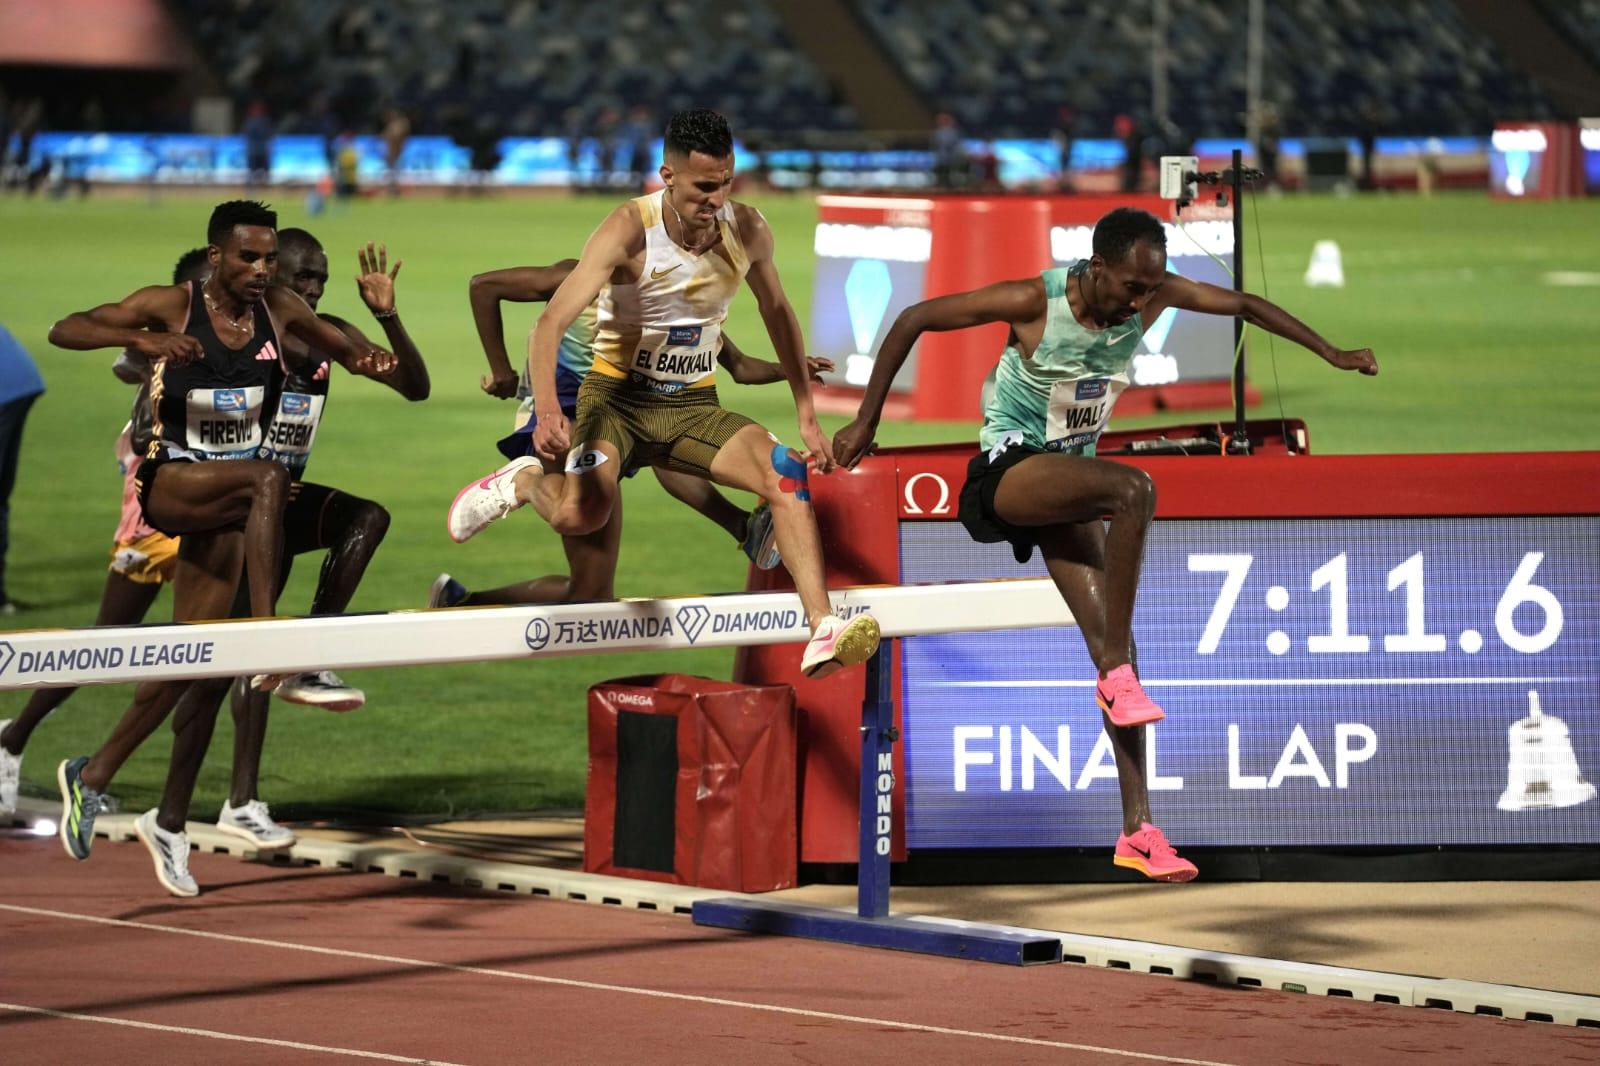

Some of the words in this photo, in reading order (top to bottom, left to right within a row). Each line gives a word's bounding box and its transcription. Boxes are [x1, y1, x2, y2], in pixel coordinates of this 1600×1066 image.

[636, 349, 652, 370] EL
[656, 350, 712, 375] BAKKALI
[269, 421, 314, 448] SEREM
[1186, 551, 1565, 656] 7:11.6
[554, 619, 598, 644] 万达
[599, 616, 674, 641] WANDA
[711, 609, 797, 634] DIAMOND
[17, 647, 124, 673] DIAMOND
[129, 642, 214, 667] LEAGUE
[617, 692, 654, 706] OMEGA
[952, 724, 1183, 793] FINAL
[1227, 723, 1378, 790] LAP
[876, 752, 892, 856] MONDO
